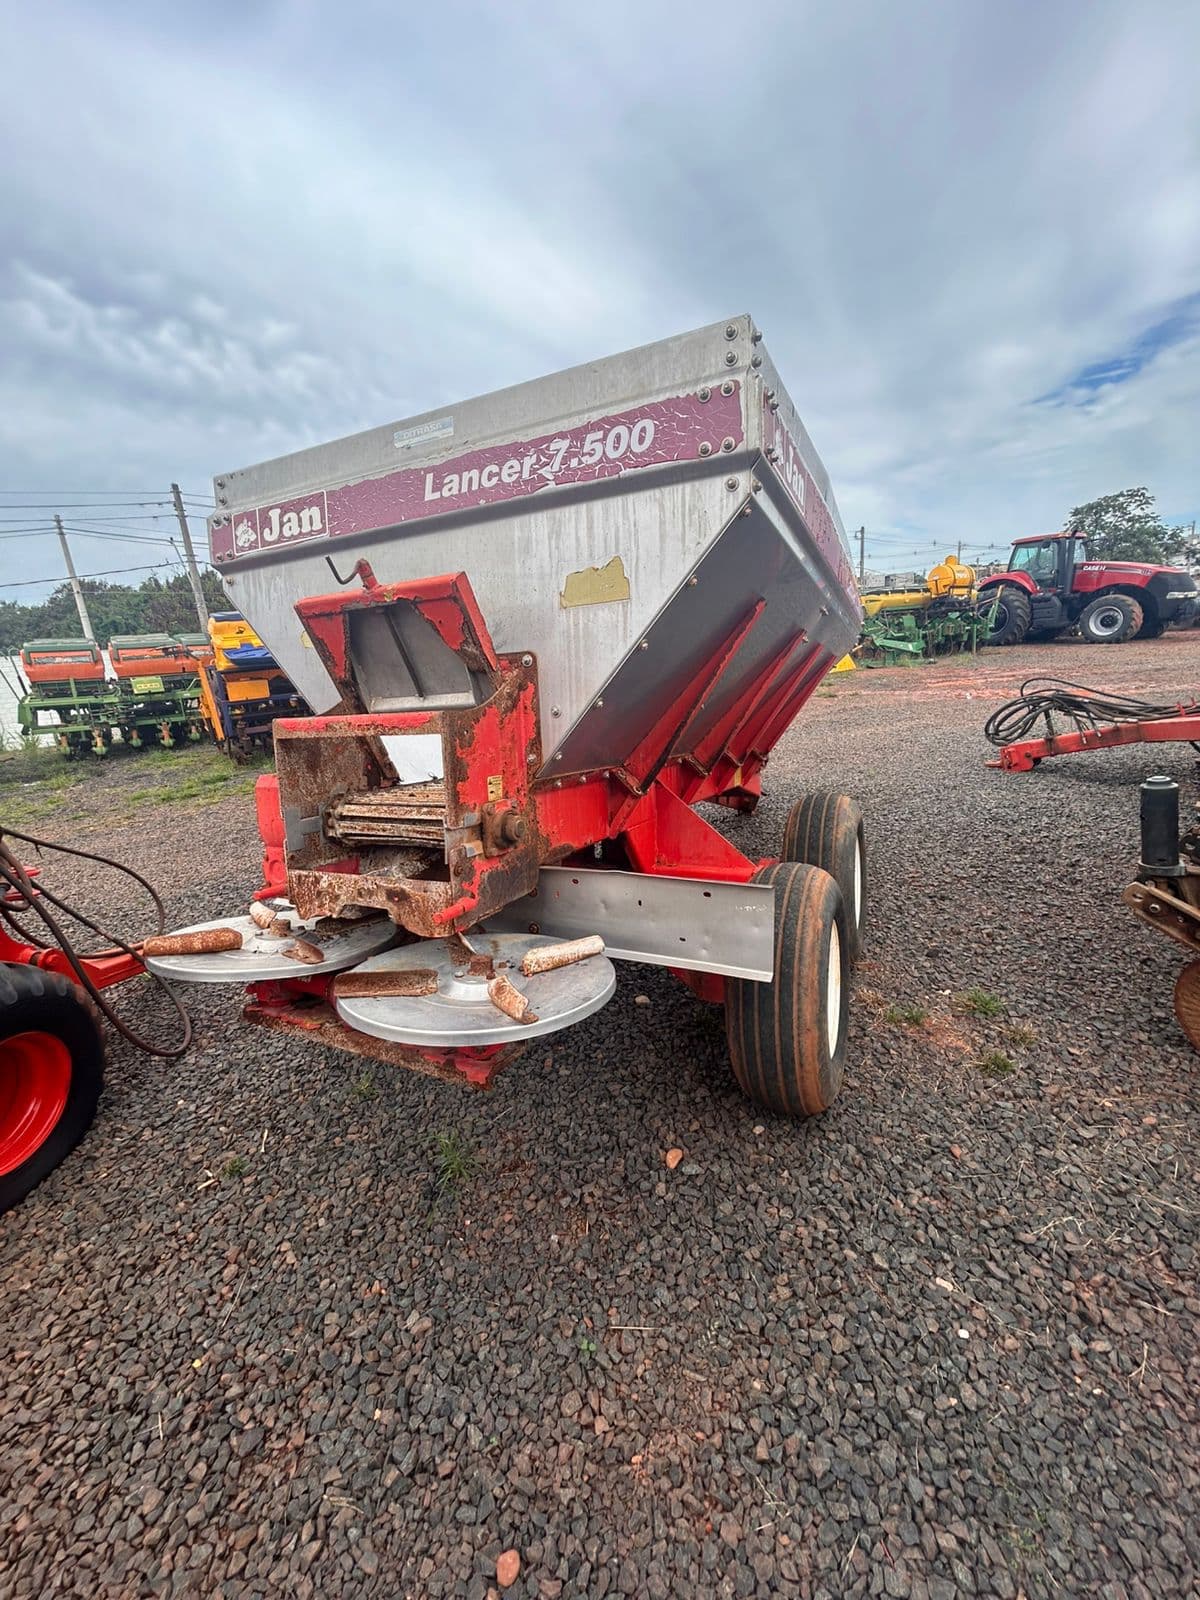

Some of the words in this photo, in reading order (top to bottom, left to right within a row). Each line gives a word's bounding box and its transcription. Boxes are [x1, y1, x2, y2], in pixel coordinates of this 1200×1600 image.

[424, 452, 537, 501] Lancer
[549, 419, 655, 472] 7.500
[785, 444, 805, 505] Jan
[263, 505, 323, 542] Jan
